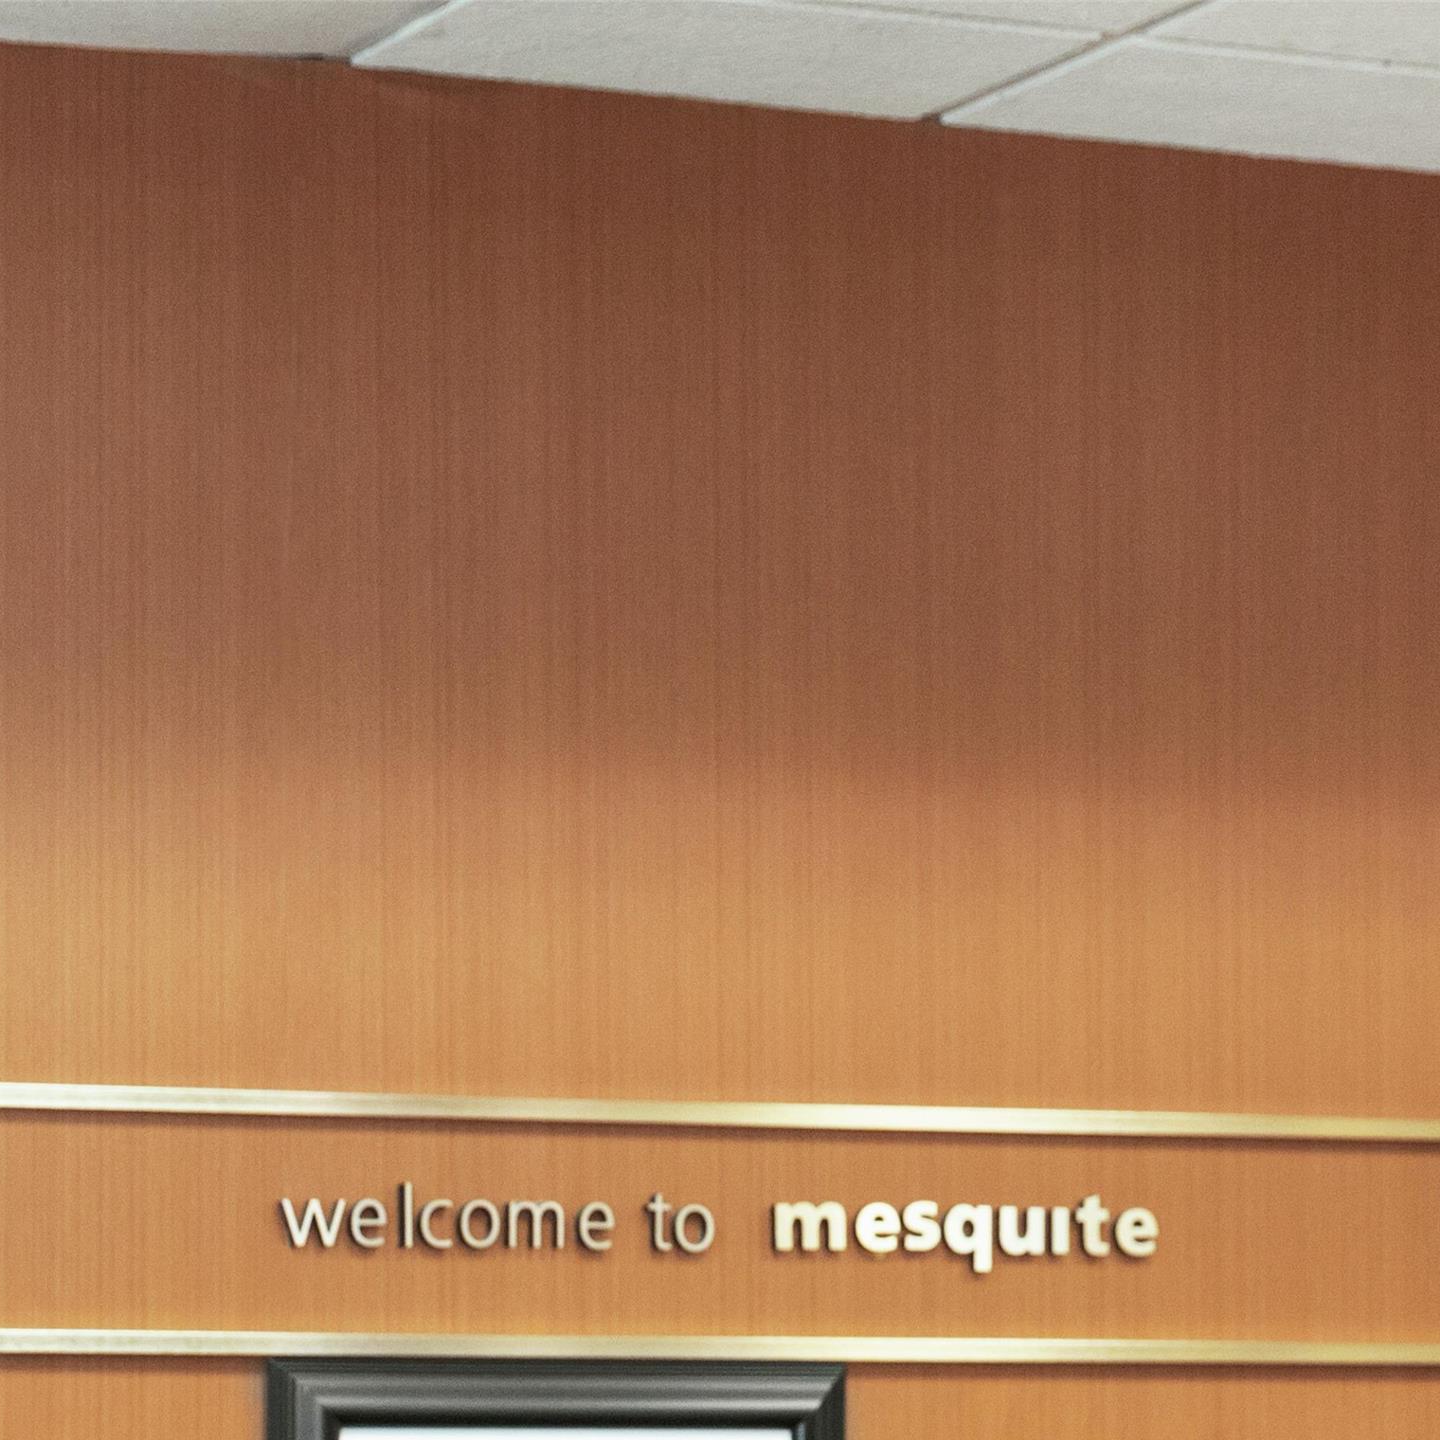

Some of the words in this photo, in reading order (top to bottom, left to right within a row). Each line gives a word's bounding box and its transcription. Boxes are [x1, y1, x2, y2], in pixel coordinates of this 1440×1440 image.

[281, 1182, 616, 1251] welcome
[647, 1193, 717, 1254] to
[772, 1193, 1161, 1274] mesquite
